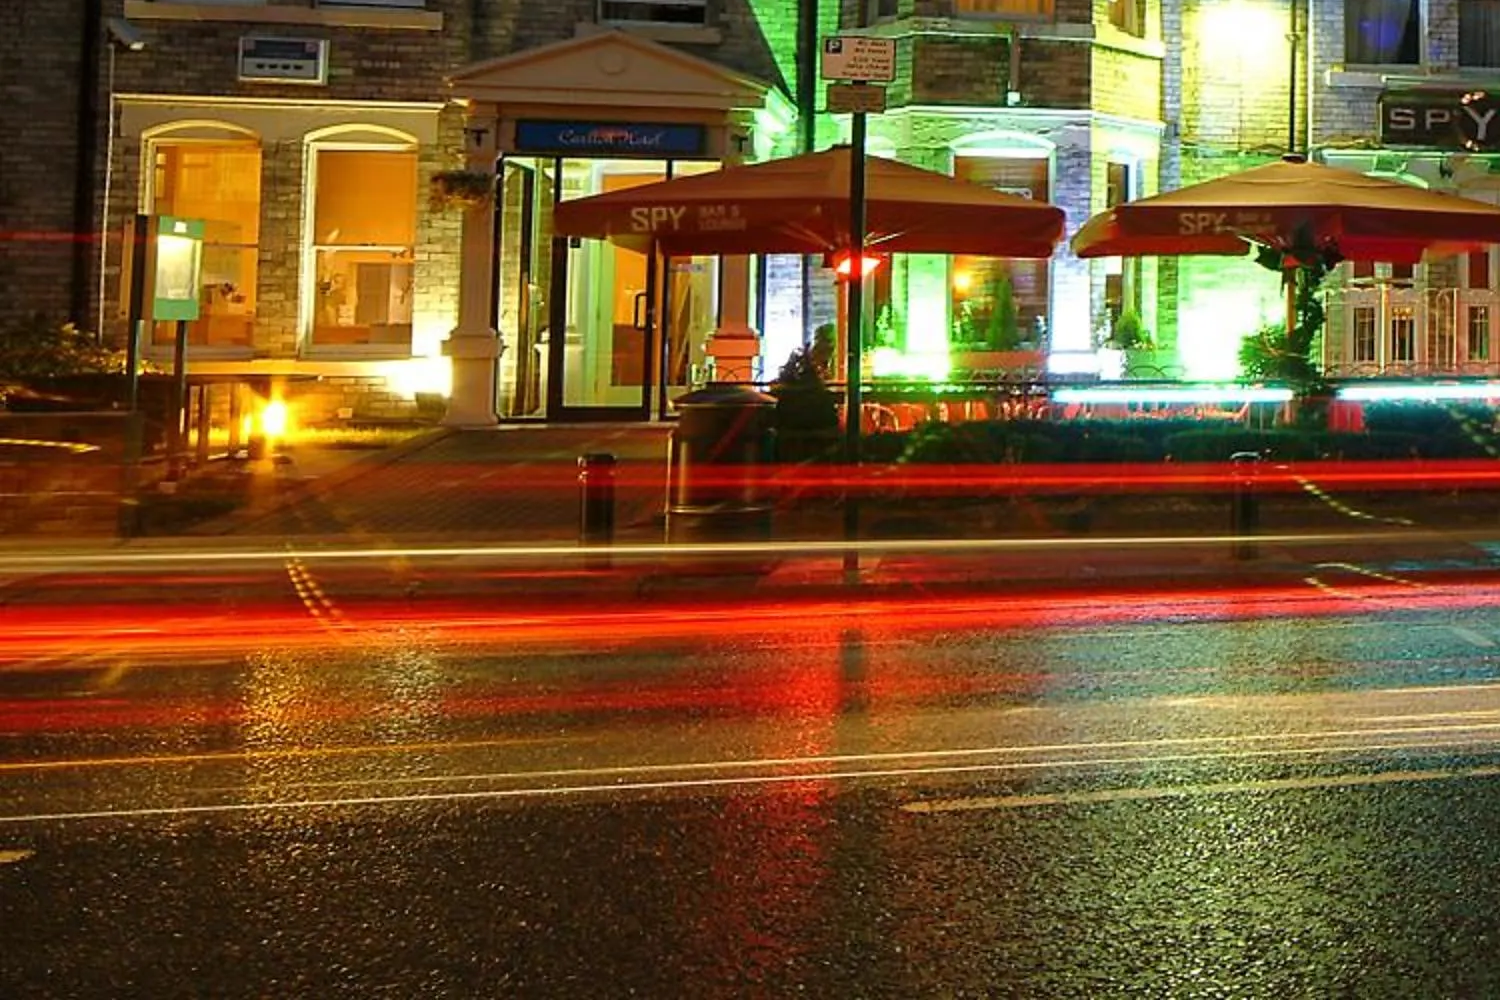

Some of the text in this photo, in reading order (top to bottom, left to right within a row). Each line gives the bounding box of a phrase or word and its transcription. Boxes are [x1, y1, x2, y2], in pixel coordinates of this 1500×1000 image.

[1389, 106, 1498, 140] SPY
[630, 206, 687, 231] SPY
[1179, 211, 1228, 235] SPY
